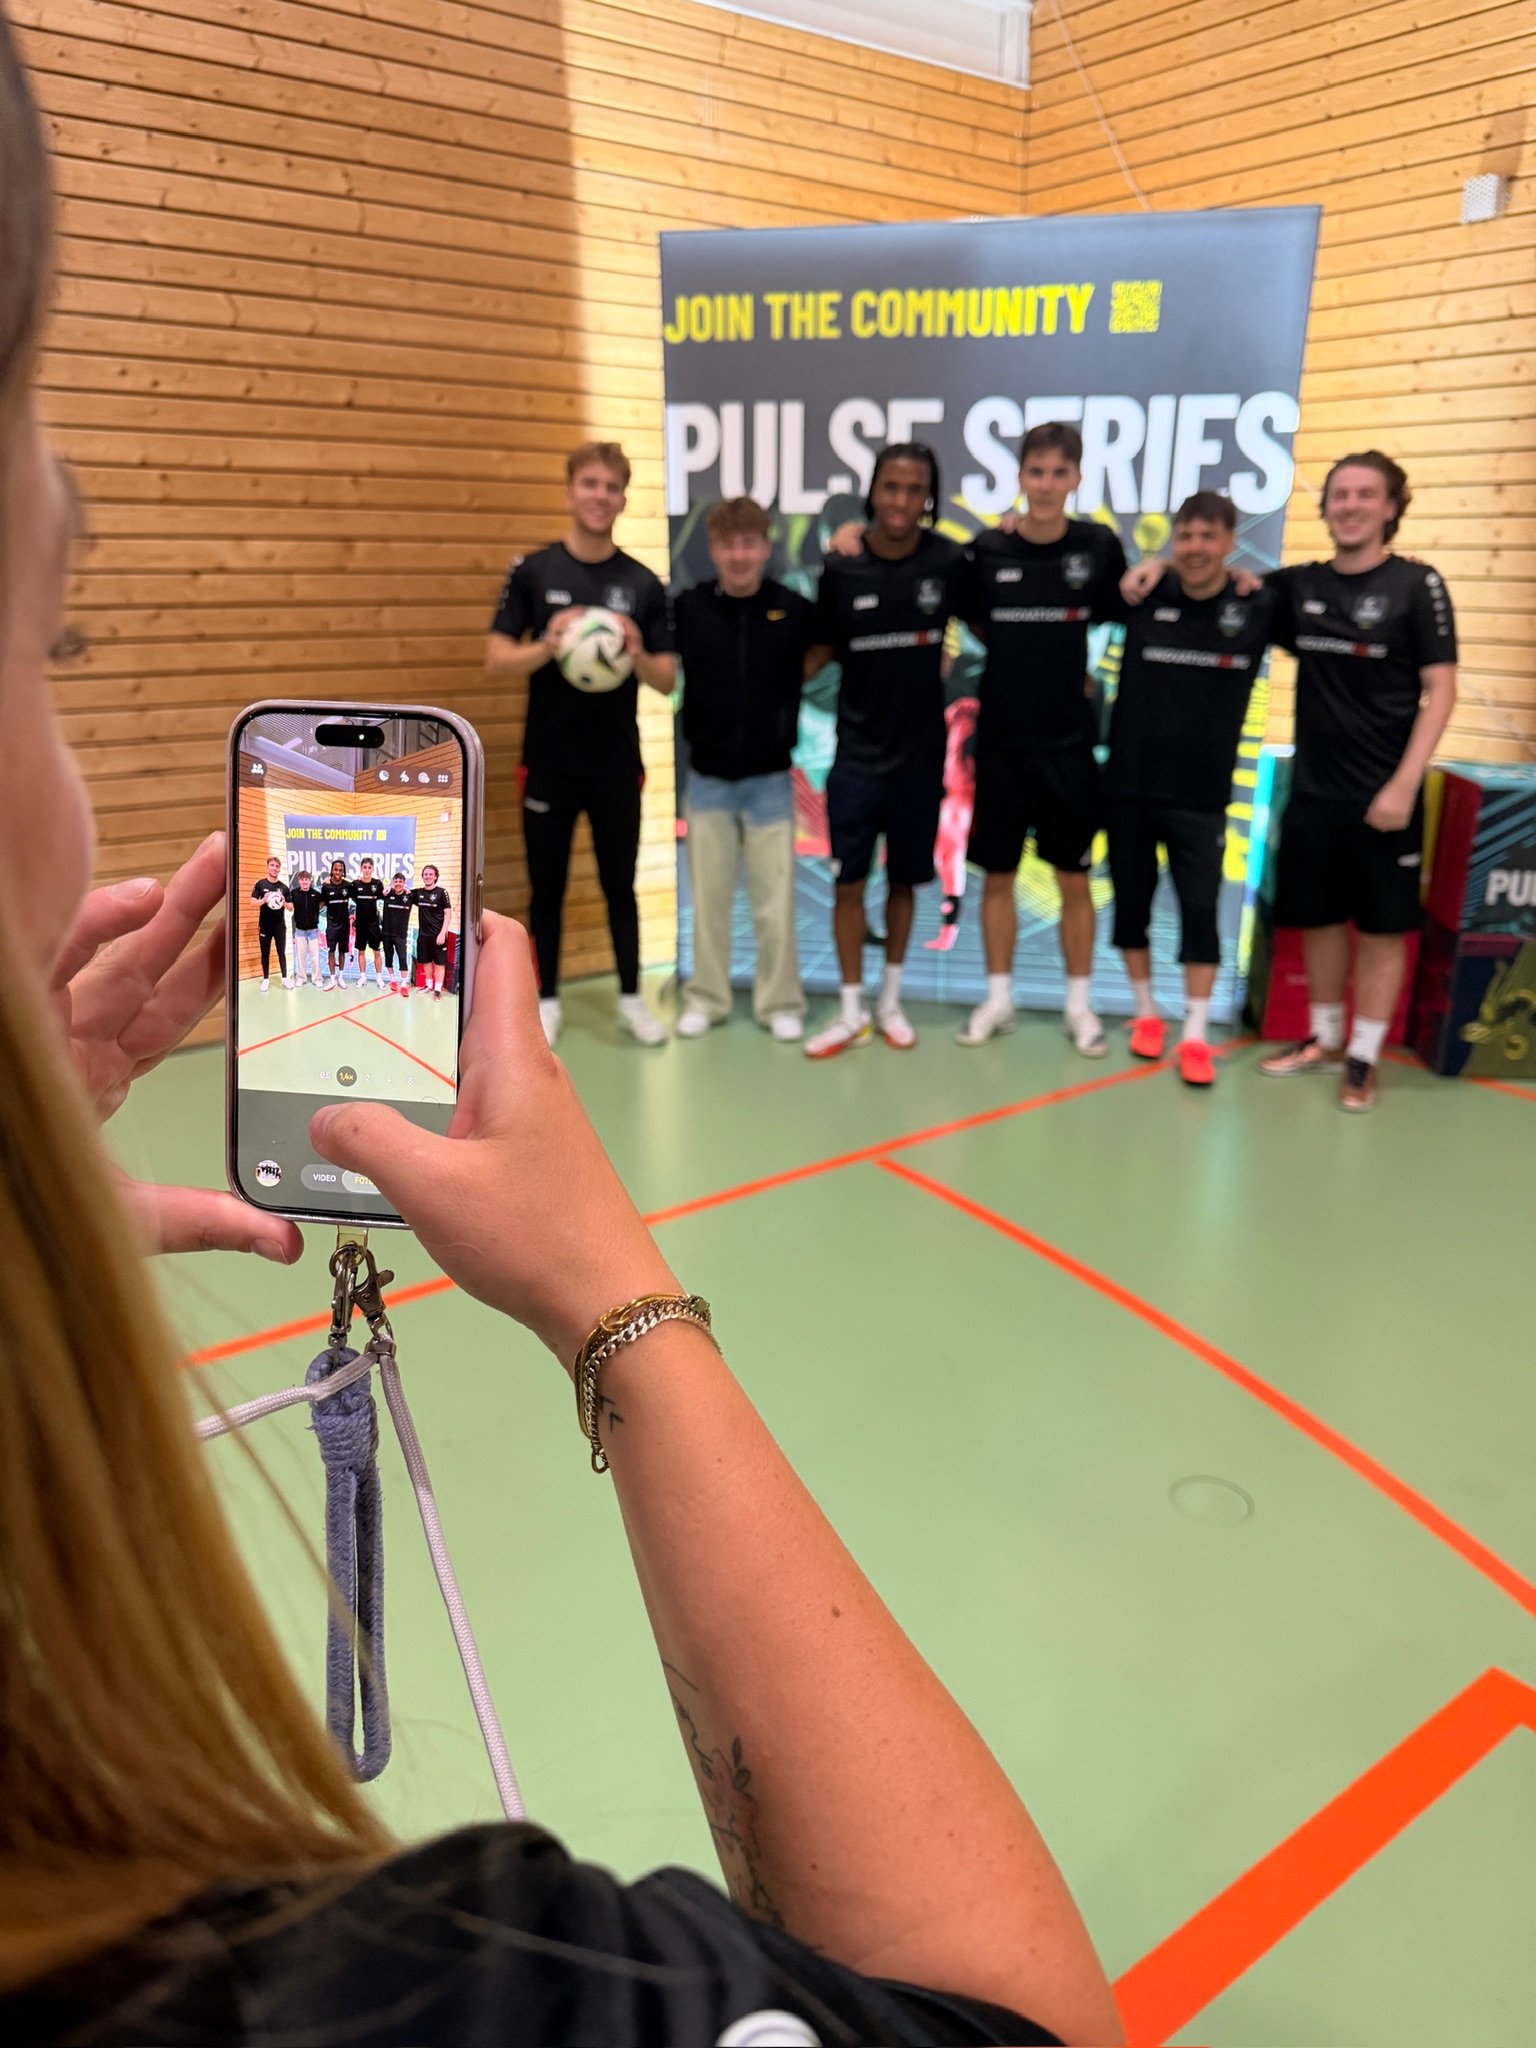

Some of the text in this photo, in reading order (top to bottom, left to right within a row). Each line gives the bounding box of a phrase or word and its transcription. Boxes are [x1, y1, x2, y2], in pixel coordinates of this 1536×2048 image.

[664, 283, 1095, 344] JOIN THE COMMUNITY
[286, 828, 373, 840] JOIN THE COMMUNITY
[1486, 869, 1536, 906] PU
[313, 1173, 336, 1183] VIDEO
